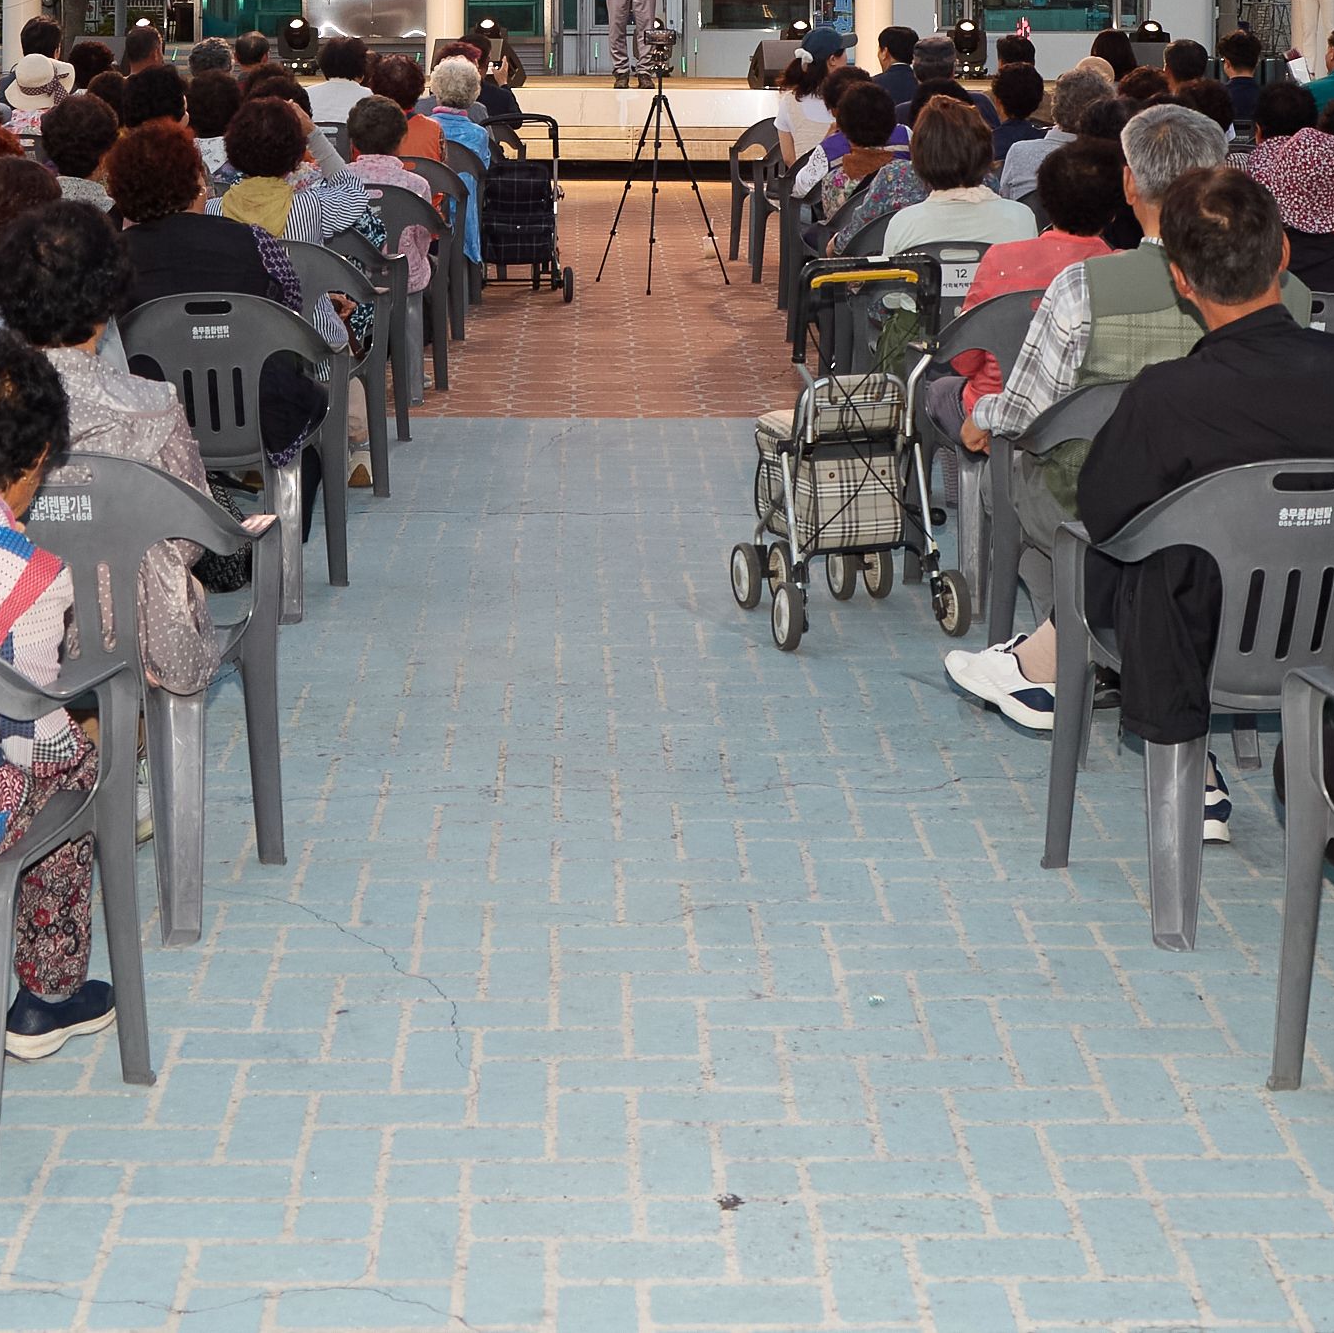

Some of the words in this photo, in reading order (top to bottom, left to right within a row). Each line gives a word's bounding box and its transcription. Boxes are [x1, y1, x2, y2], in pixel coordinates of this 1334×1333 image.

[955, 268, 968, 279] 12
[30, 512, 93, 522] 055-642-1658
[1278, 506, 1333, 520] 충무종합렌탈
[1278, 519, 1332, 527] 055-644-2014
